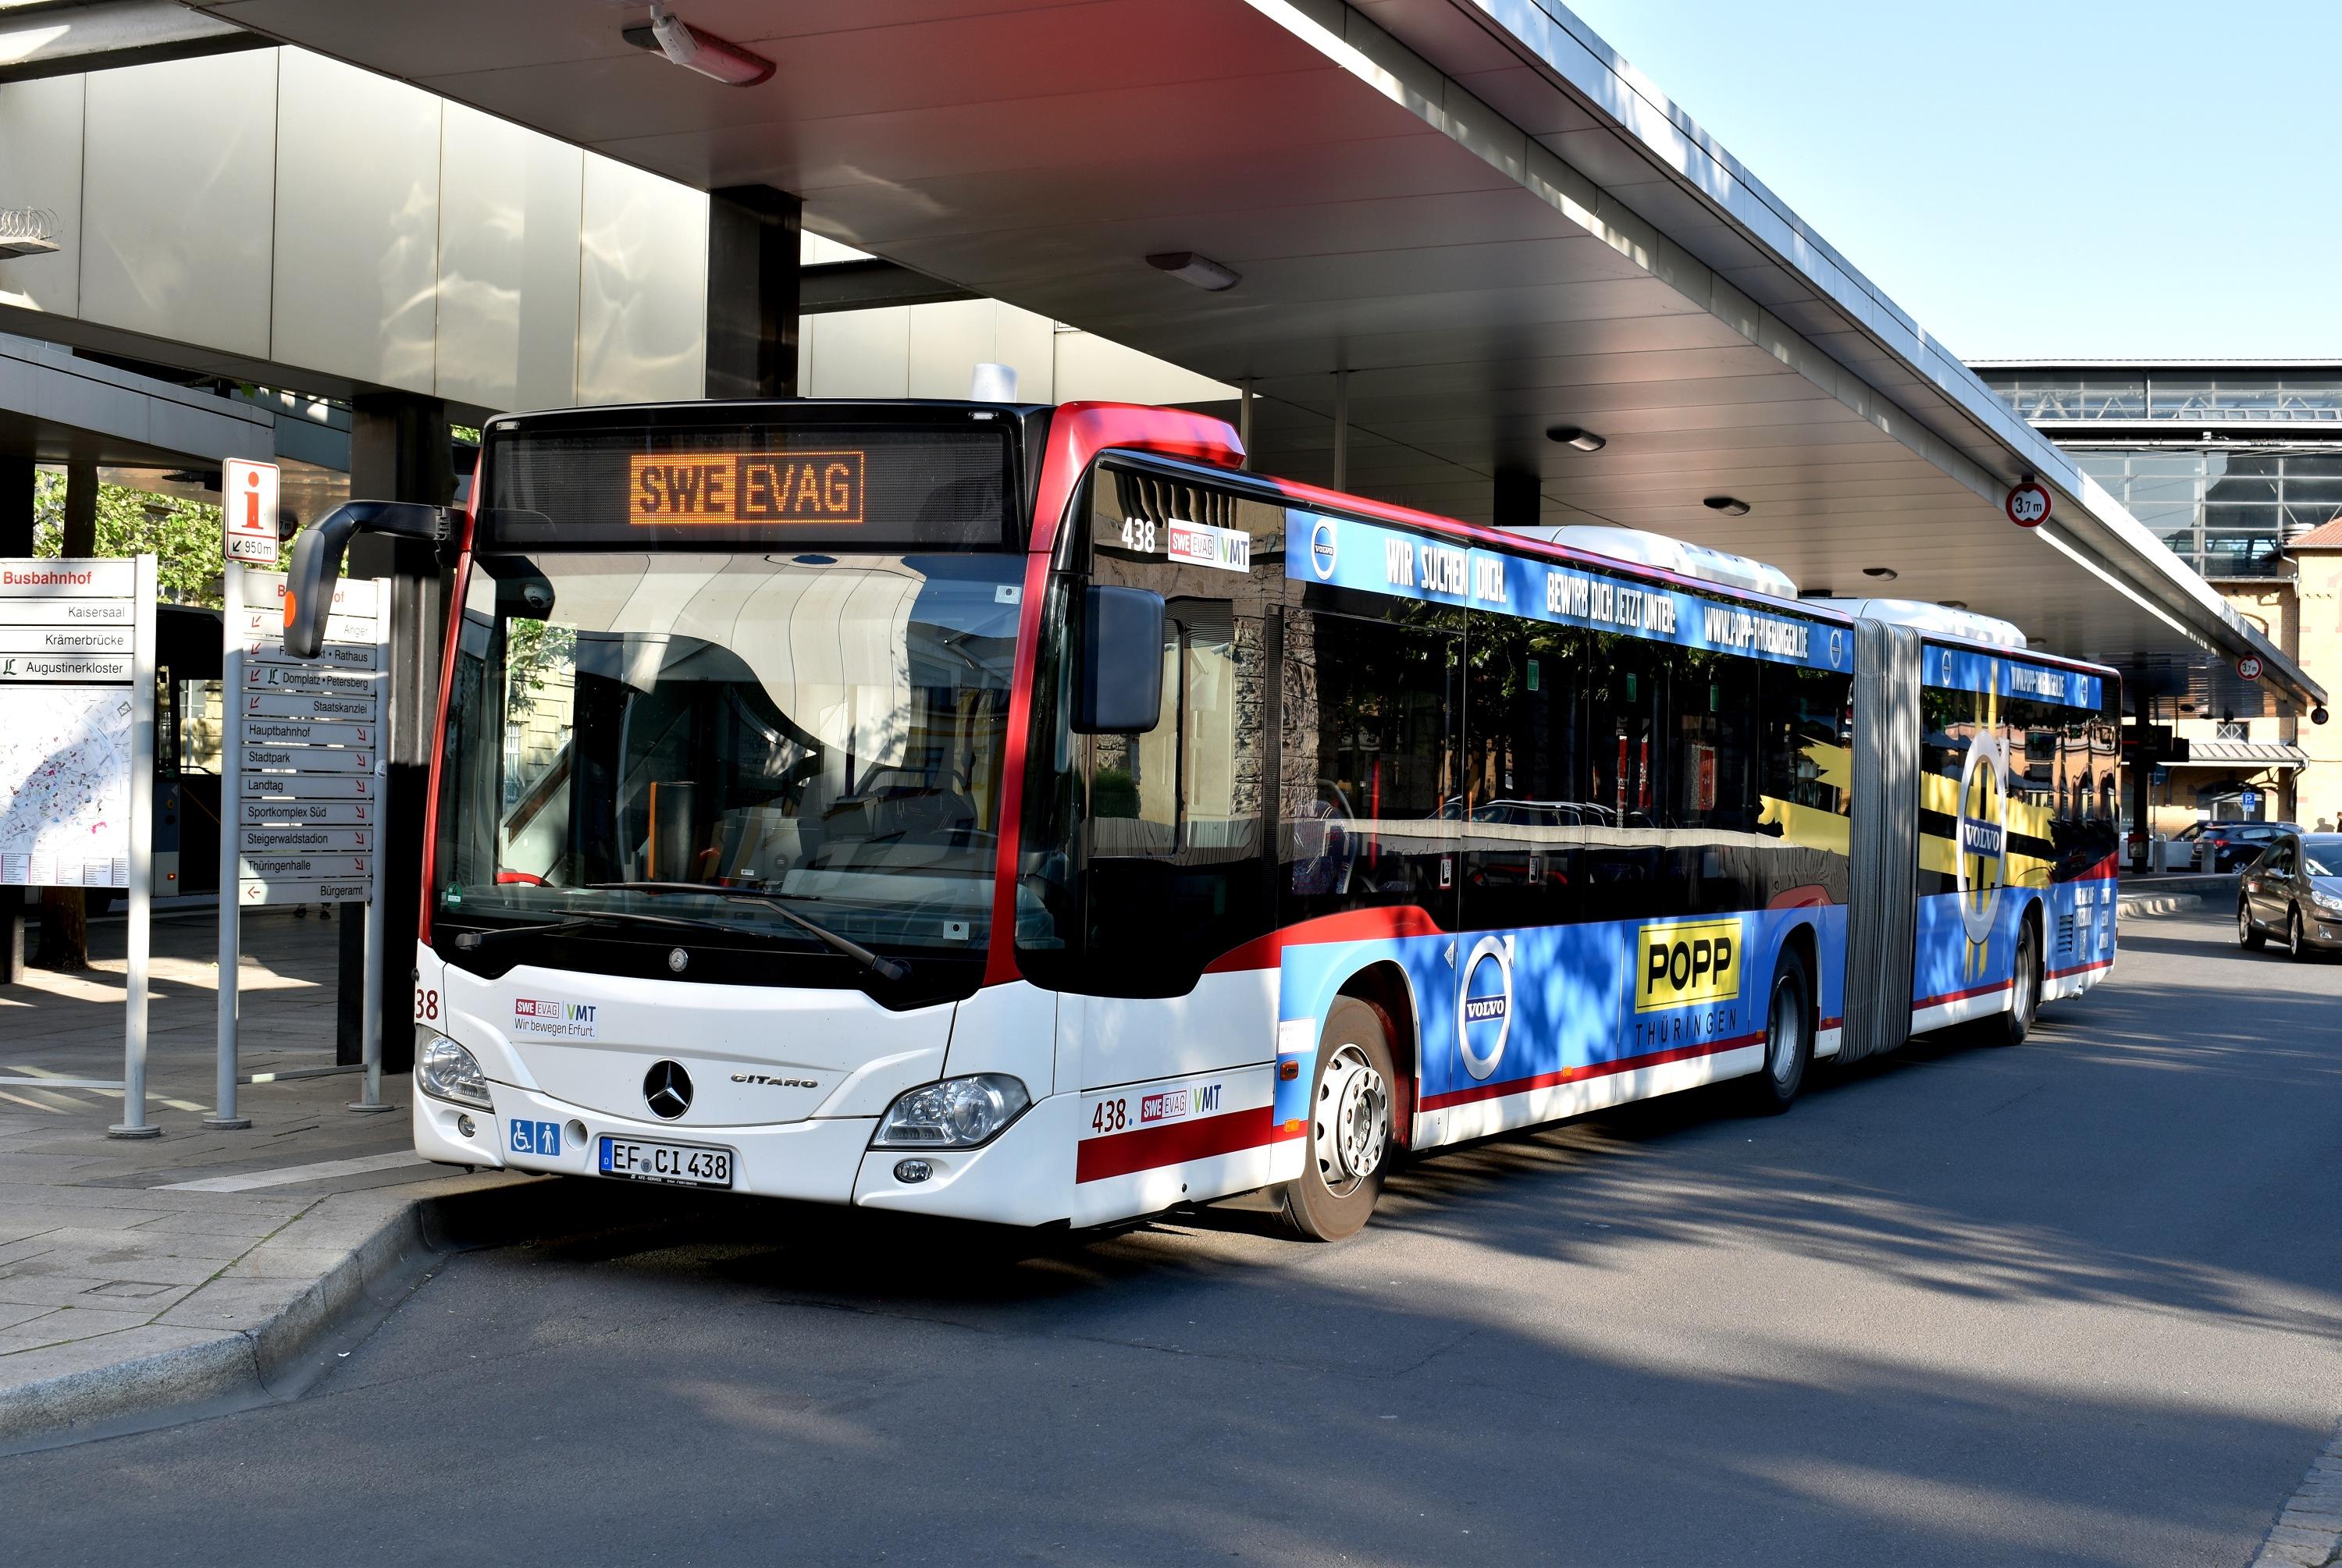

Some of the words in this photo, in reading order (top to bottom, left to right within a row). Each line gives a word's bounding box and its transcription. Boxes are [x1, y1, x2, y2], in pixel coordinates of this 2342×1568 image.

[639, 465, 727, 513] SWE
[747, 464, 849, 512] EVAG
[2015, 496, 2031, 514] 3.7
[2033, 503, 2042, 512] m
[1121, 517, 1155, 553] 438
[1172, 532, 1191, 552] SWE
[1193, 533, 1213, 559] EVAG
[1220, 536, 1248, 567] VMT
[1315, 545, 1333, 554] VOLVO
[1385, 537, 1414, 587] WIR
[1421, 546, 1468, 596] SUCHEN
[3, 571, 92, 585] Busbahnhof
[1547, 572, 1589, 617] BEWIRB
[1591, 581, 1614, 622] DICH
[1615, 586, 1642, 628] JETZT
[1644, 592, 1676, 634] UNTER:
[69, 606, 125, 617] Kaisersaal
[344, 624, 368, 638] Anger
[1704, 606, 1808, 658] WWW.POPP-THUERINGEN.DE
[45, 634, 124, 645] Krämerbrücke
[334, 649, 368, 662] Rathaus
[26, 662, 123, 675] Augustinerkloster
[283, 673, 321, 686] Domplatz
[327, 675, 368, 691] Petersberg
[313, 701, 368, 714] Staatskanzlei
[249, 724, 311, 738] Hauptbahnhof
[249, 752, 290, 764] Stadtpark
[248, 780, 283, 792] Landtag
[248, 806, 307, 820] Sportkomplex
[310, 806, 326, 817] Süd
[247, 833, 328, 847] Steigerwaldstadion
[1964, 823, 2000, 852] VOLVO
[247, 861, 311, 873] Thüringenhalle
[320, 886, 363, 898] Bürgeramt
[1647, 937, 1732, 994] POPP
[517, 1001, 535, 1014] SWE
[537, 1002, 557, 1016] EVAG
[567, 1004, 596, 1022] VMT
[1467, 1000, 1504, 1019] VOLVO
[514, 1018, 529, 1030] Wir
[531, 1019, 567, 1036] bewegen
[568, 1023, 596, 1037] Erfurt.
[1635, 1008, 1736, 1047] THÜRINGEN
[731, 1073, 818, 1088] CITARO
[1143, 1098, 1162, 1118] SWE
[1165, 1095, 1186, 1115] EVAG
[1194, 1084, 1222, 1114] VMT
[614, 1144, 640, 1169] EF
[655, 1149, 681, 1175] CI
[688, 1152, 727, 1179] 438
